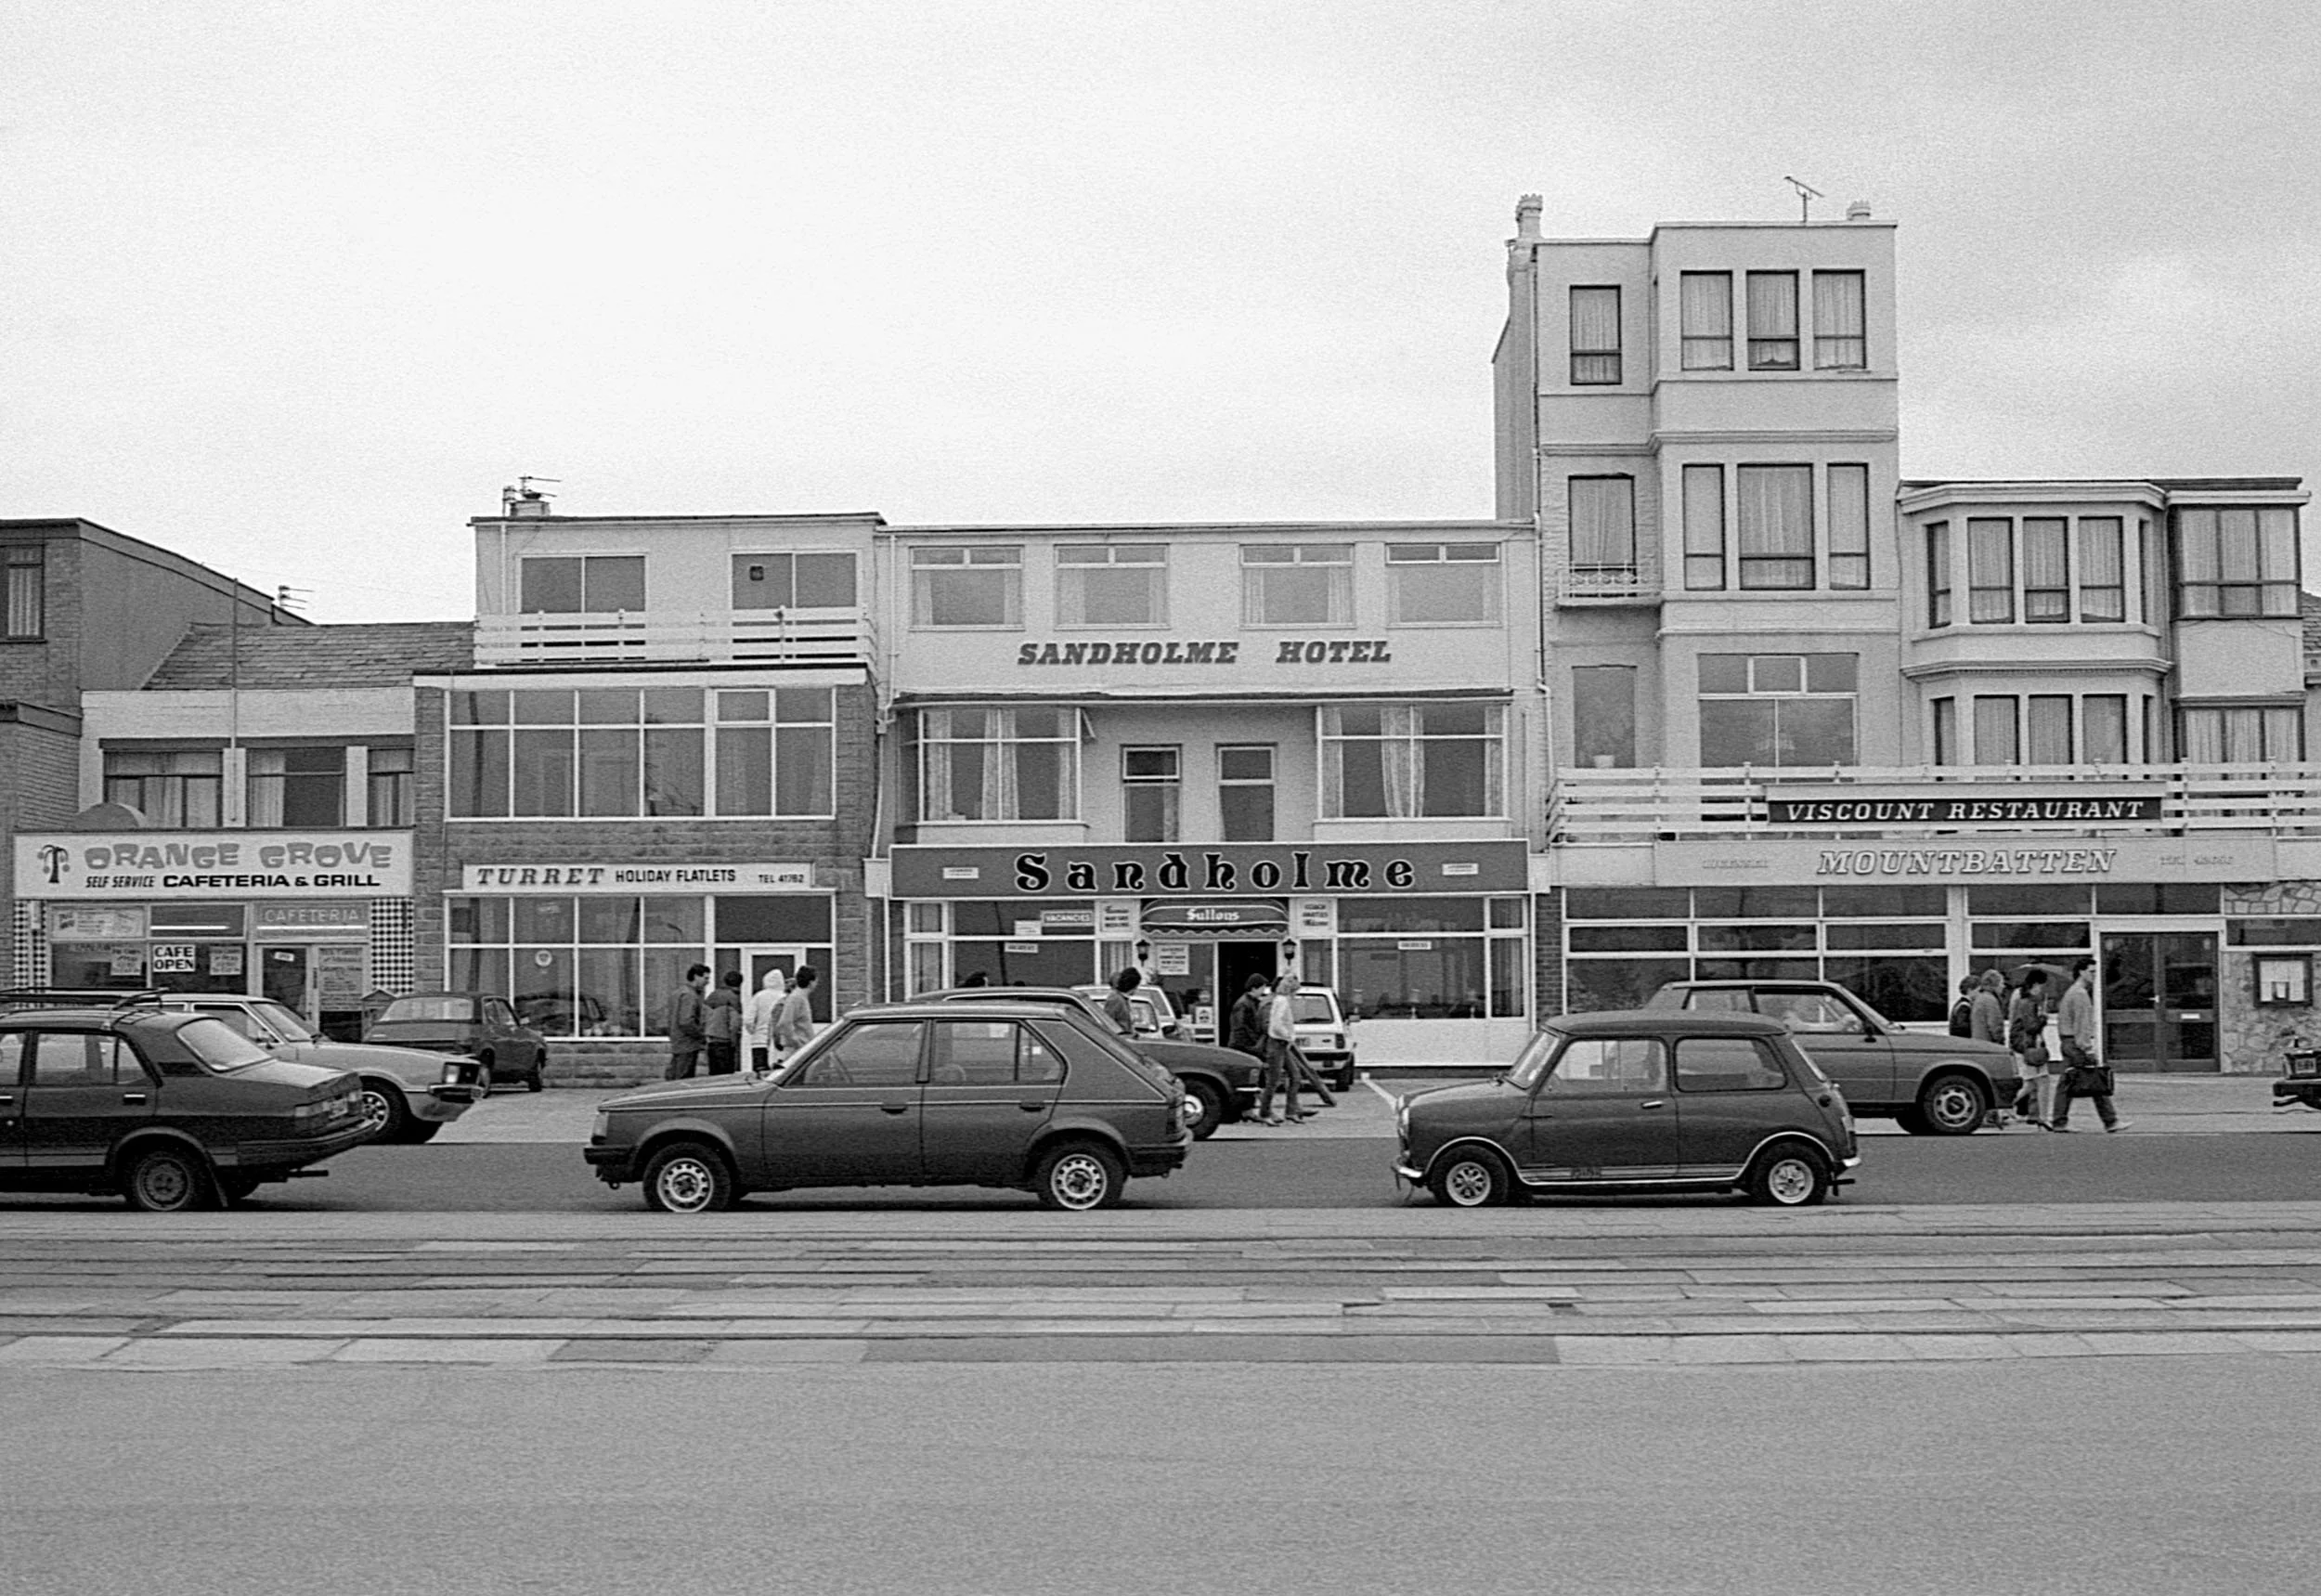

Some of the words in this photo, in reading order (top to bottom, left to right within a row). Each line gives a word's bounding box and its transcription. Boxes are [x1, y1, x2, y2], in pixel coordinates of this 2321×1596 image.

[1018, 642, 1239, 665] SANDHOLME
[1276, 641, 1391, 664] HOTEL
[1787, 803, 1934, 821] VISCOUNT
[1947, 801, 2144, 820] RESTAURANT
[84, 842, 240, 869] ORANGE
[259, 841, 391, 869] GROVE
[1816, 850, 2114, 875] MOUNTBATTEN
[477, 867, 605, 885] TURRET
[616, 869, 671, 883] HOLIDAY
[676, 869, 736, 883] FLATLETS
[758, 874, 775, 884] TEL
[1012, 851, 1413, 891] Sandholme
[85, 875, 110, 889] SELF
[111, 875, 156, 889] SERVICE
[162, 875, 290, 888] CAFETERIA
[294, 876, 309, 888] &
[314, 875, 382, 888] GRILL
[265, 909, 359, 922] CAFETERIA
[1045, 914, 1091, 923] VACANCIES
[154, 946, 194, 957] CAFE
[154, 959, 194, 970] OPEN
